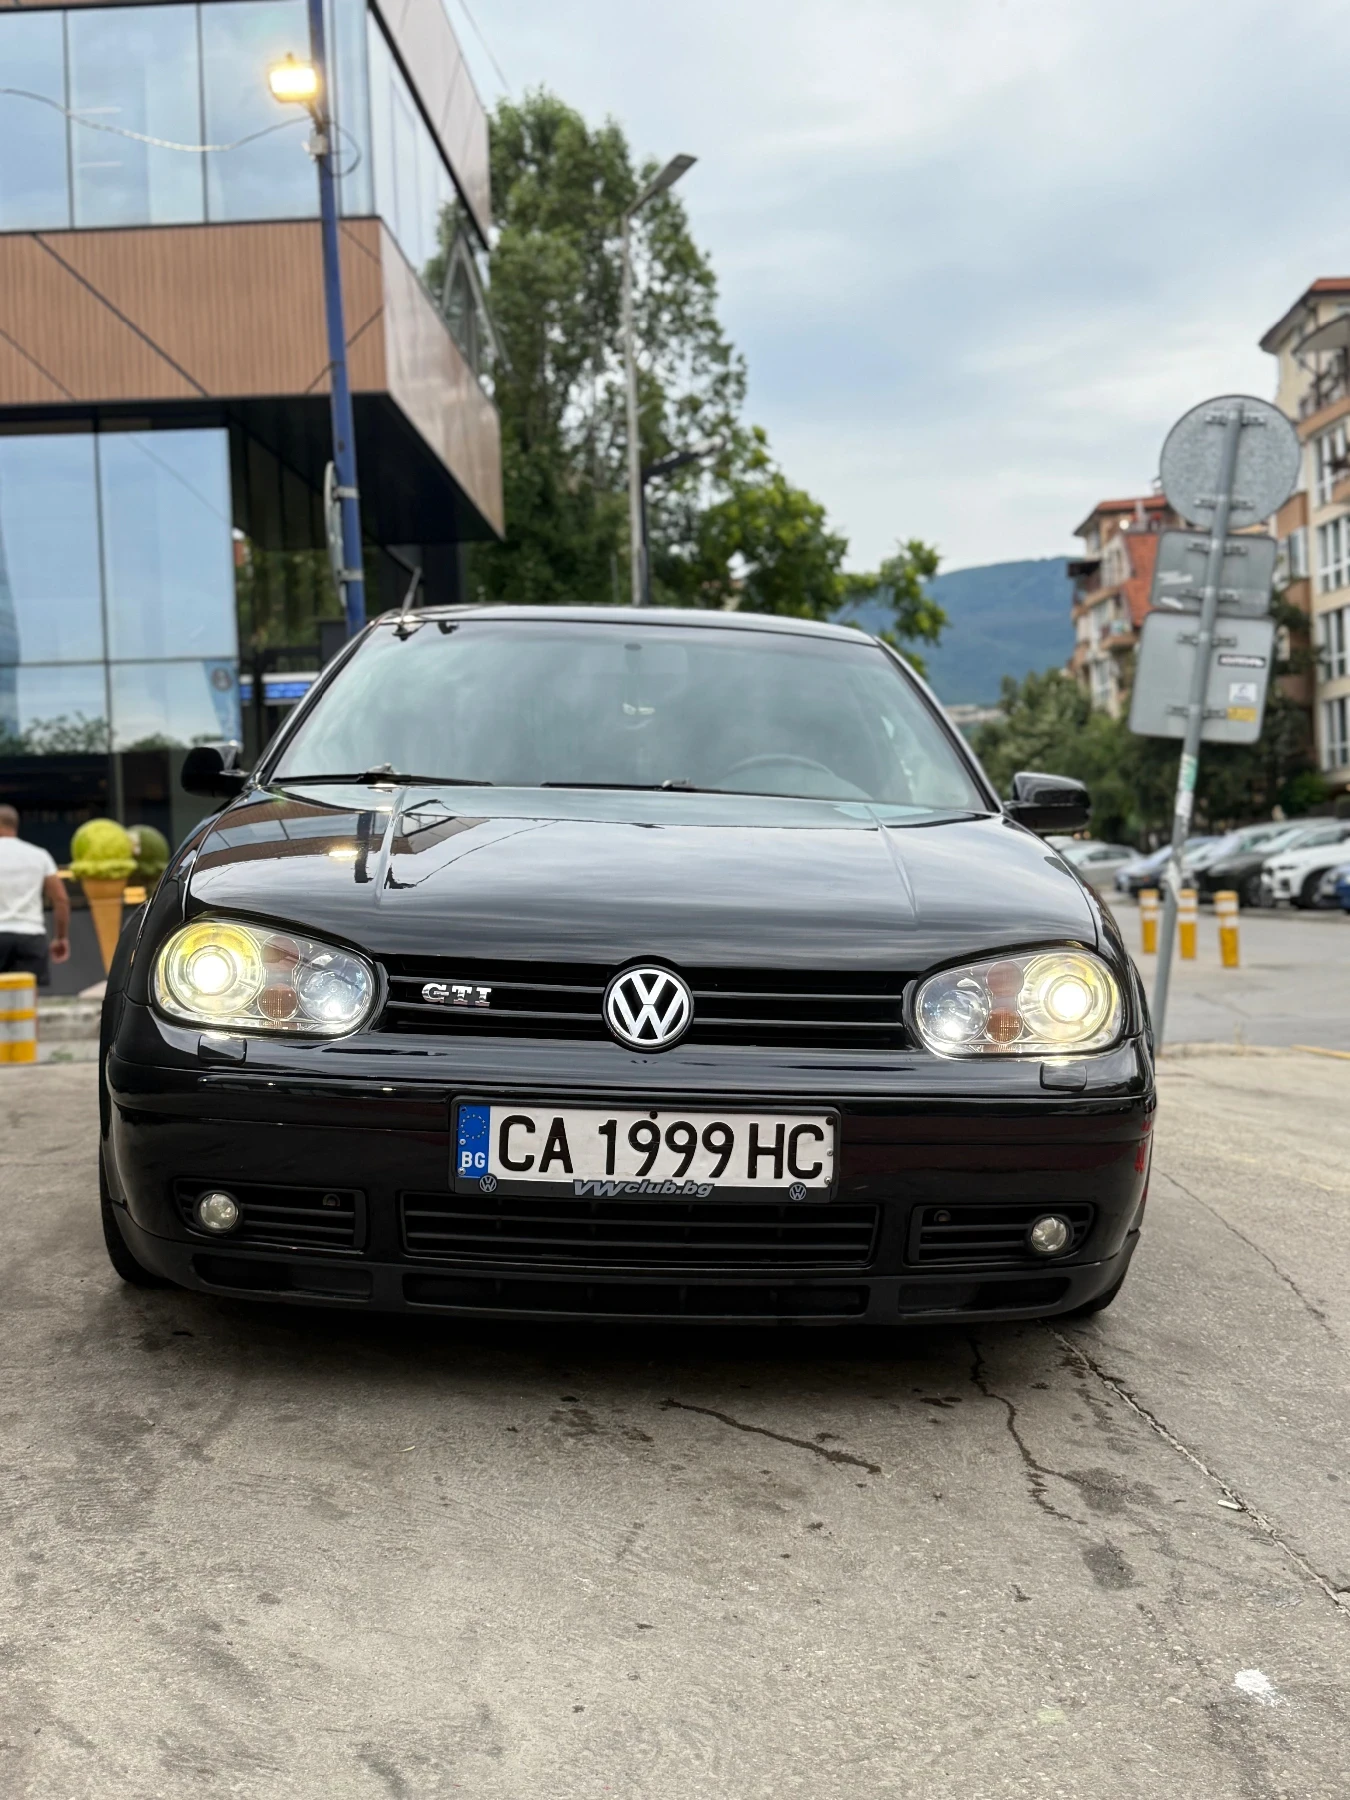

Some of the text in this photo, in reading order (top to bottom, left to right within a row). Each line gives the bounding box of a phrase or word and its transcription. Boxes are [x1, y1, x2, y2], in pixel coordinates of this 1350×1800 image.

[421, 982, 492, 1008] GTI
[607, 967, 691, 1046] VW
[461, 1151, 486, 1169] BG
[499, 1114, 825, 1180] CA 1999 HC
